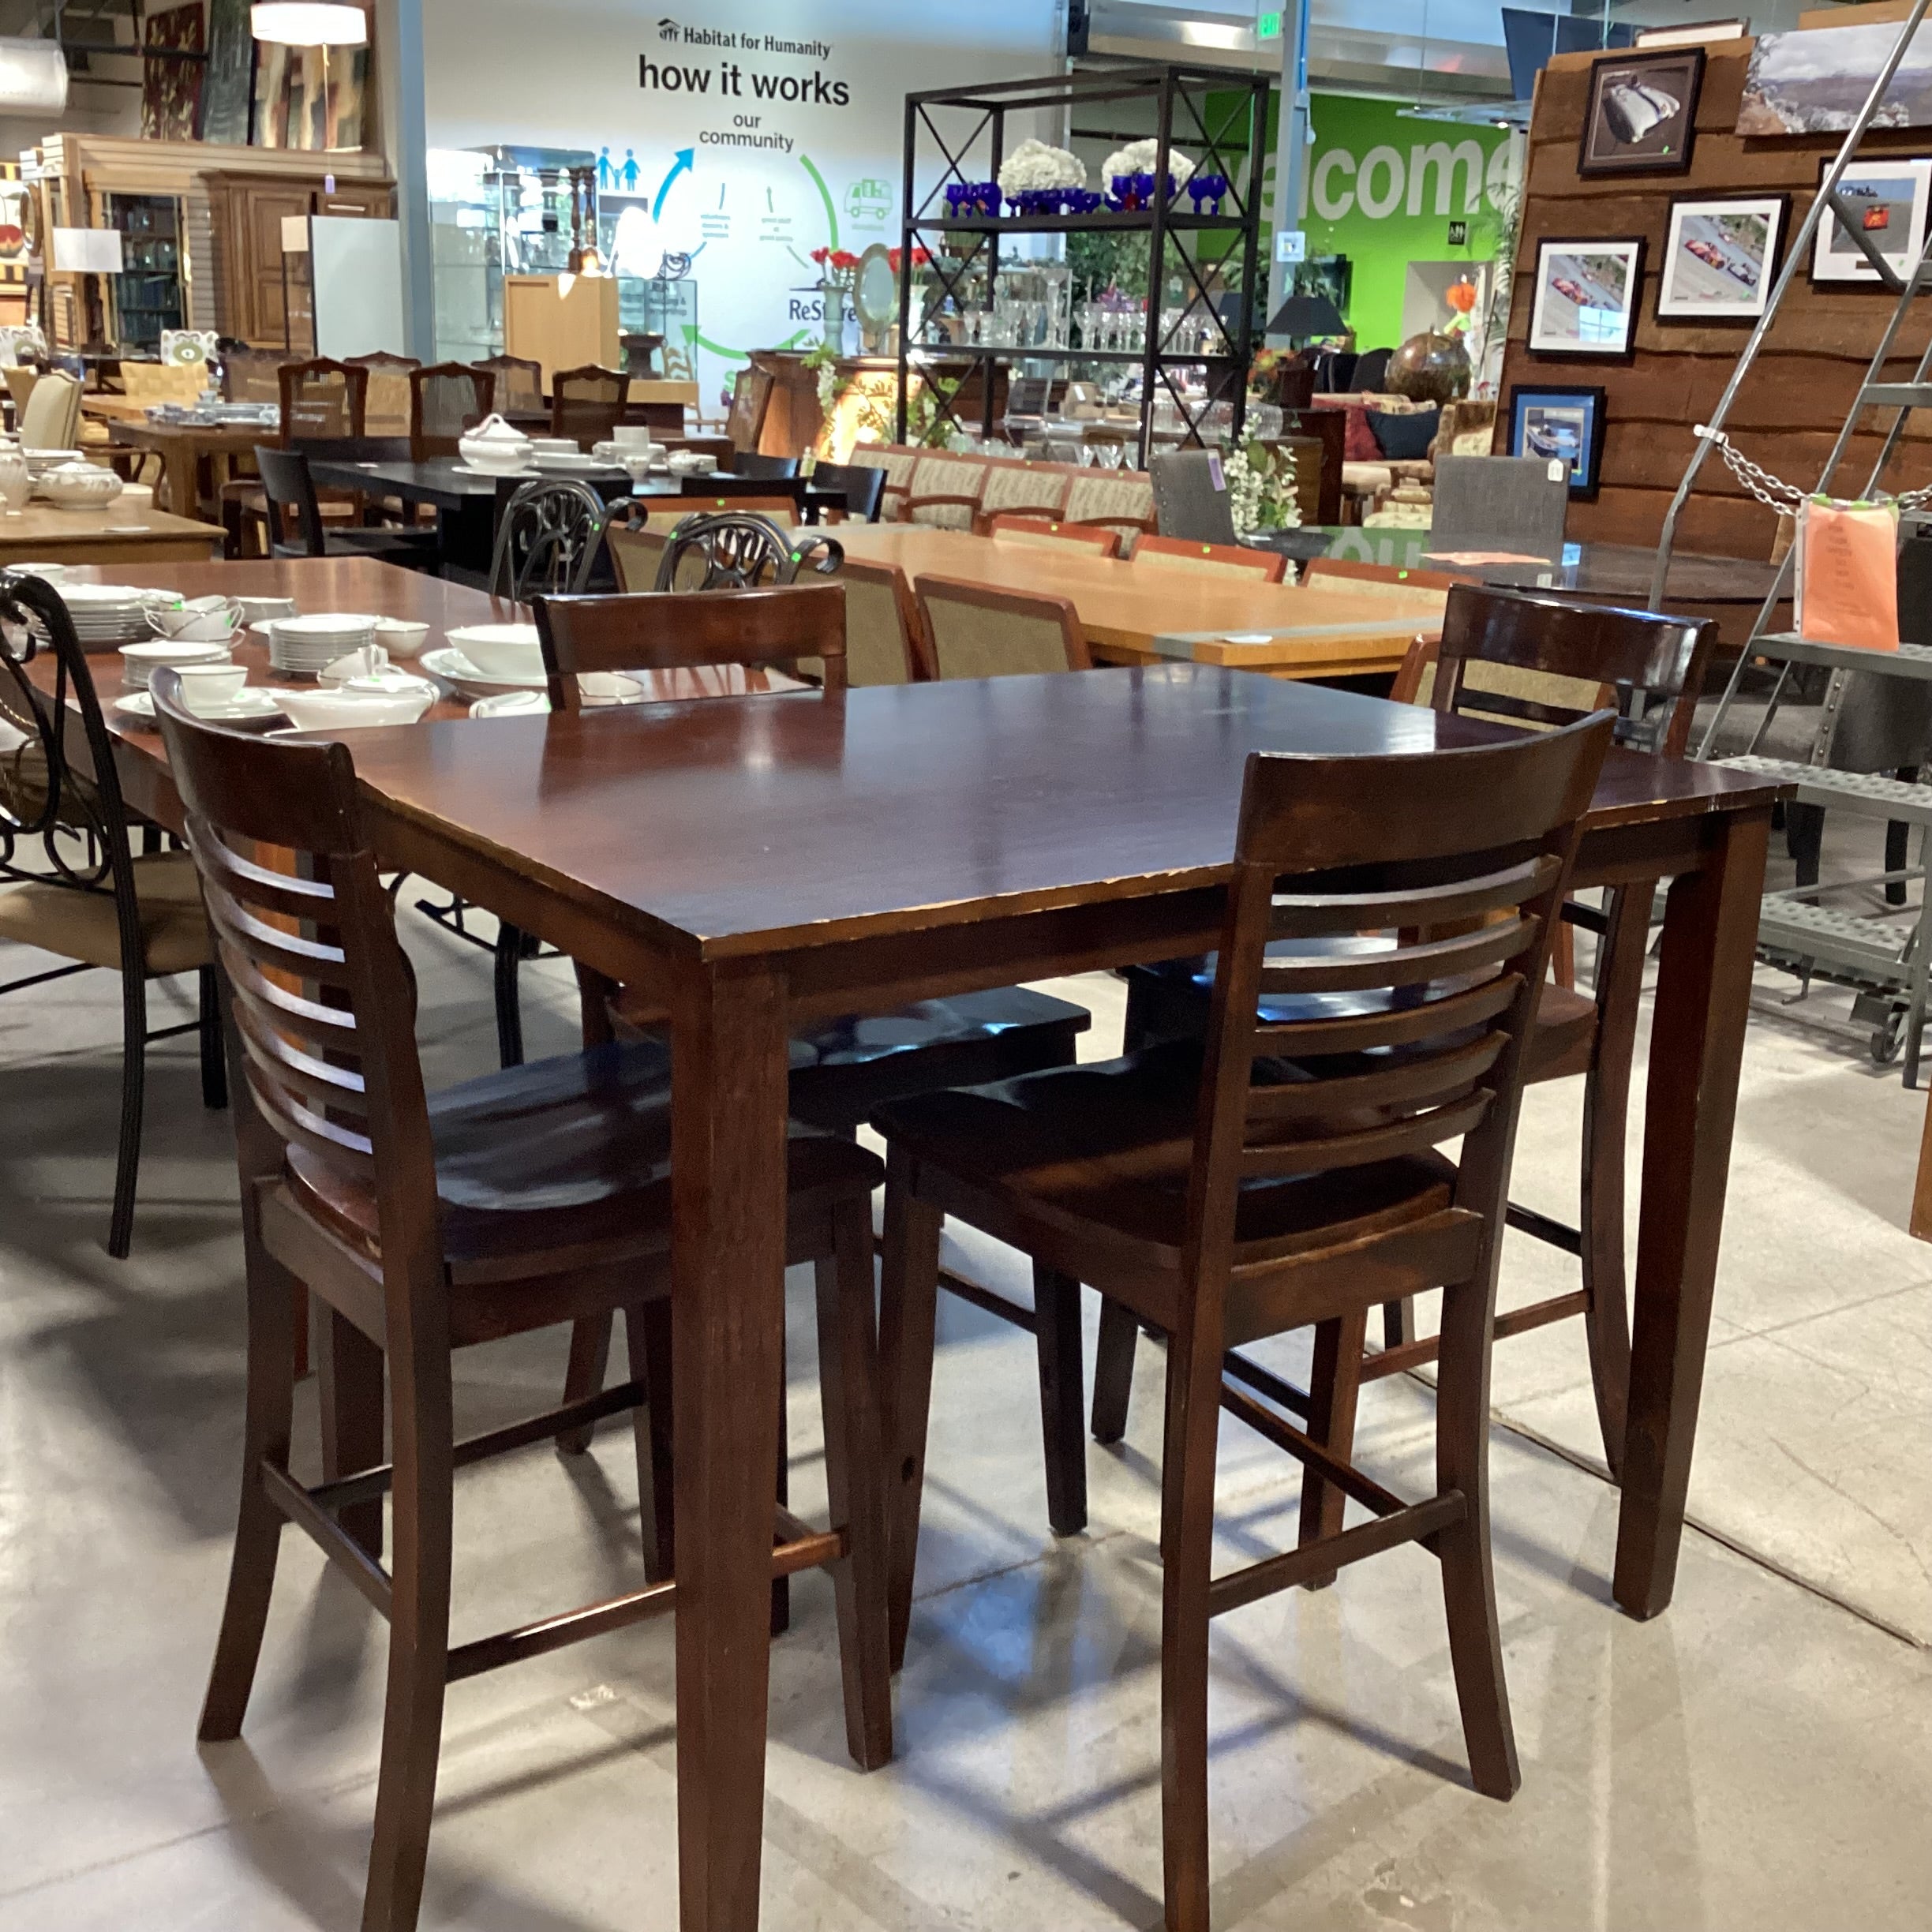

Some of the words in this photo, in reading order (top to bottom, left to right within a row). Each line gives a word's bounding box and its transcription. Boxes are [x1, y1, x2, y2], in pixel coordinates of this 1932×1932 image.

[683, 28, 736, 48] Habitat
[740, 33, 760, 51] for
[764, 36, 831, 61] Humanity
[639, 54, 711, 93] how
[721, 62, 742, 96] it
[752, 71, 849, 106] works
[733, 114, 762, 129] our
[699, 130, 794, 153] community
[1200, 138, 1511, 222] wlcom
[789, 299, 857, 322] ReSre
